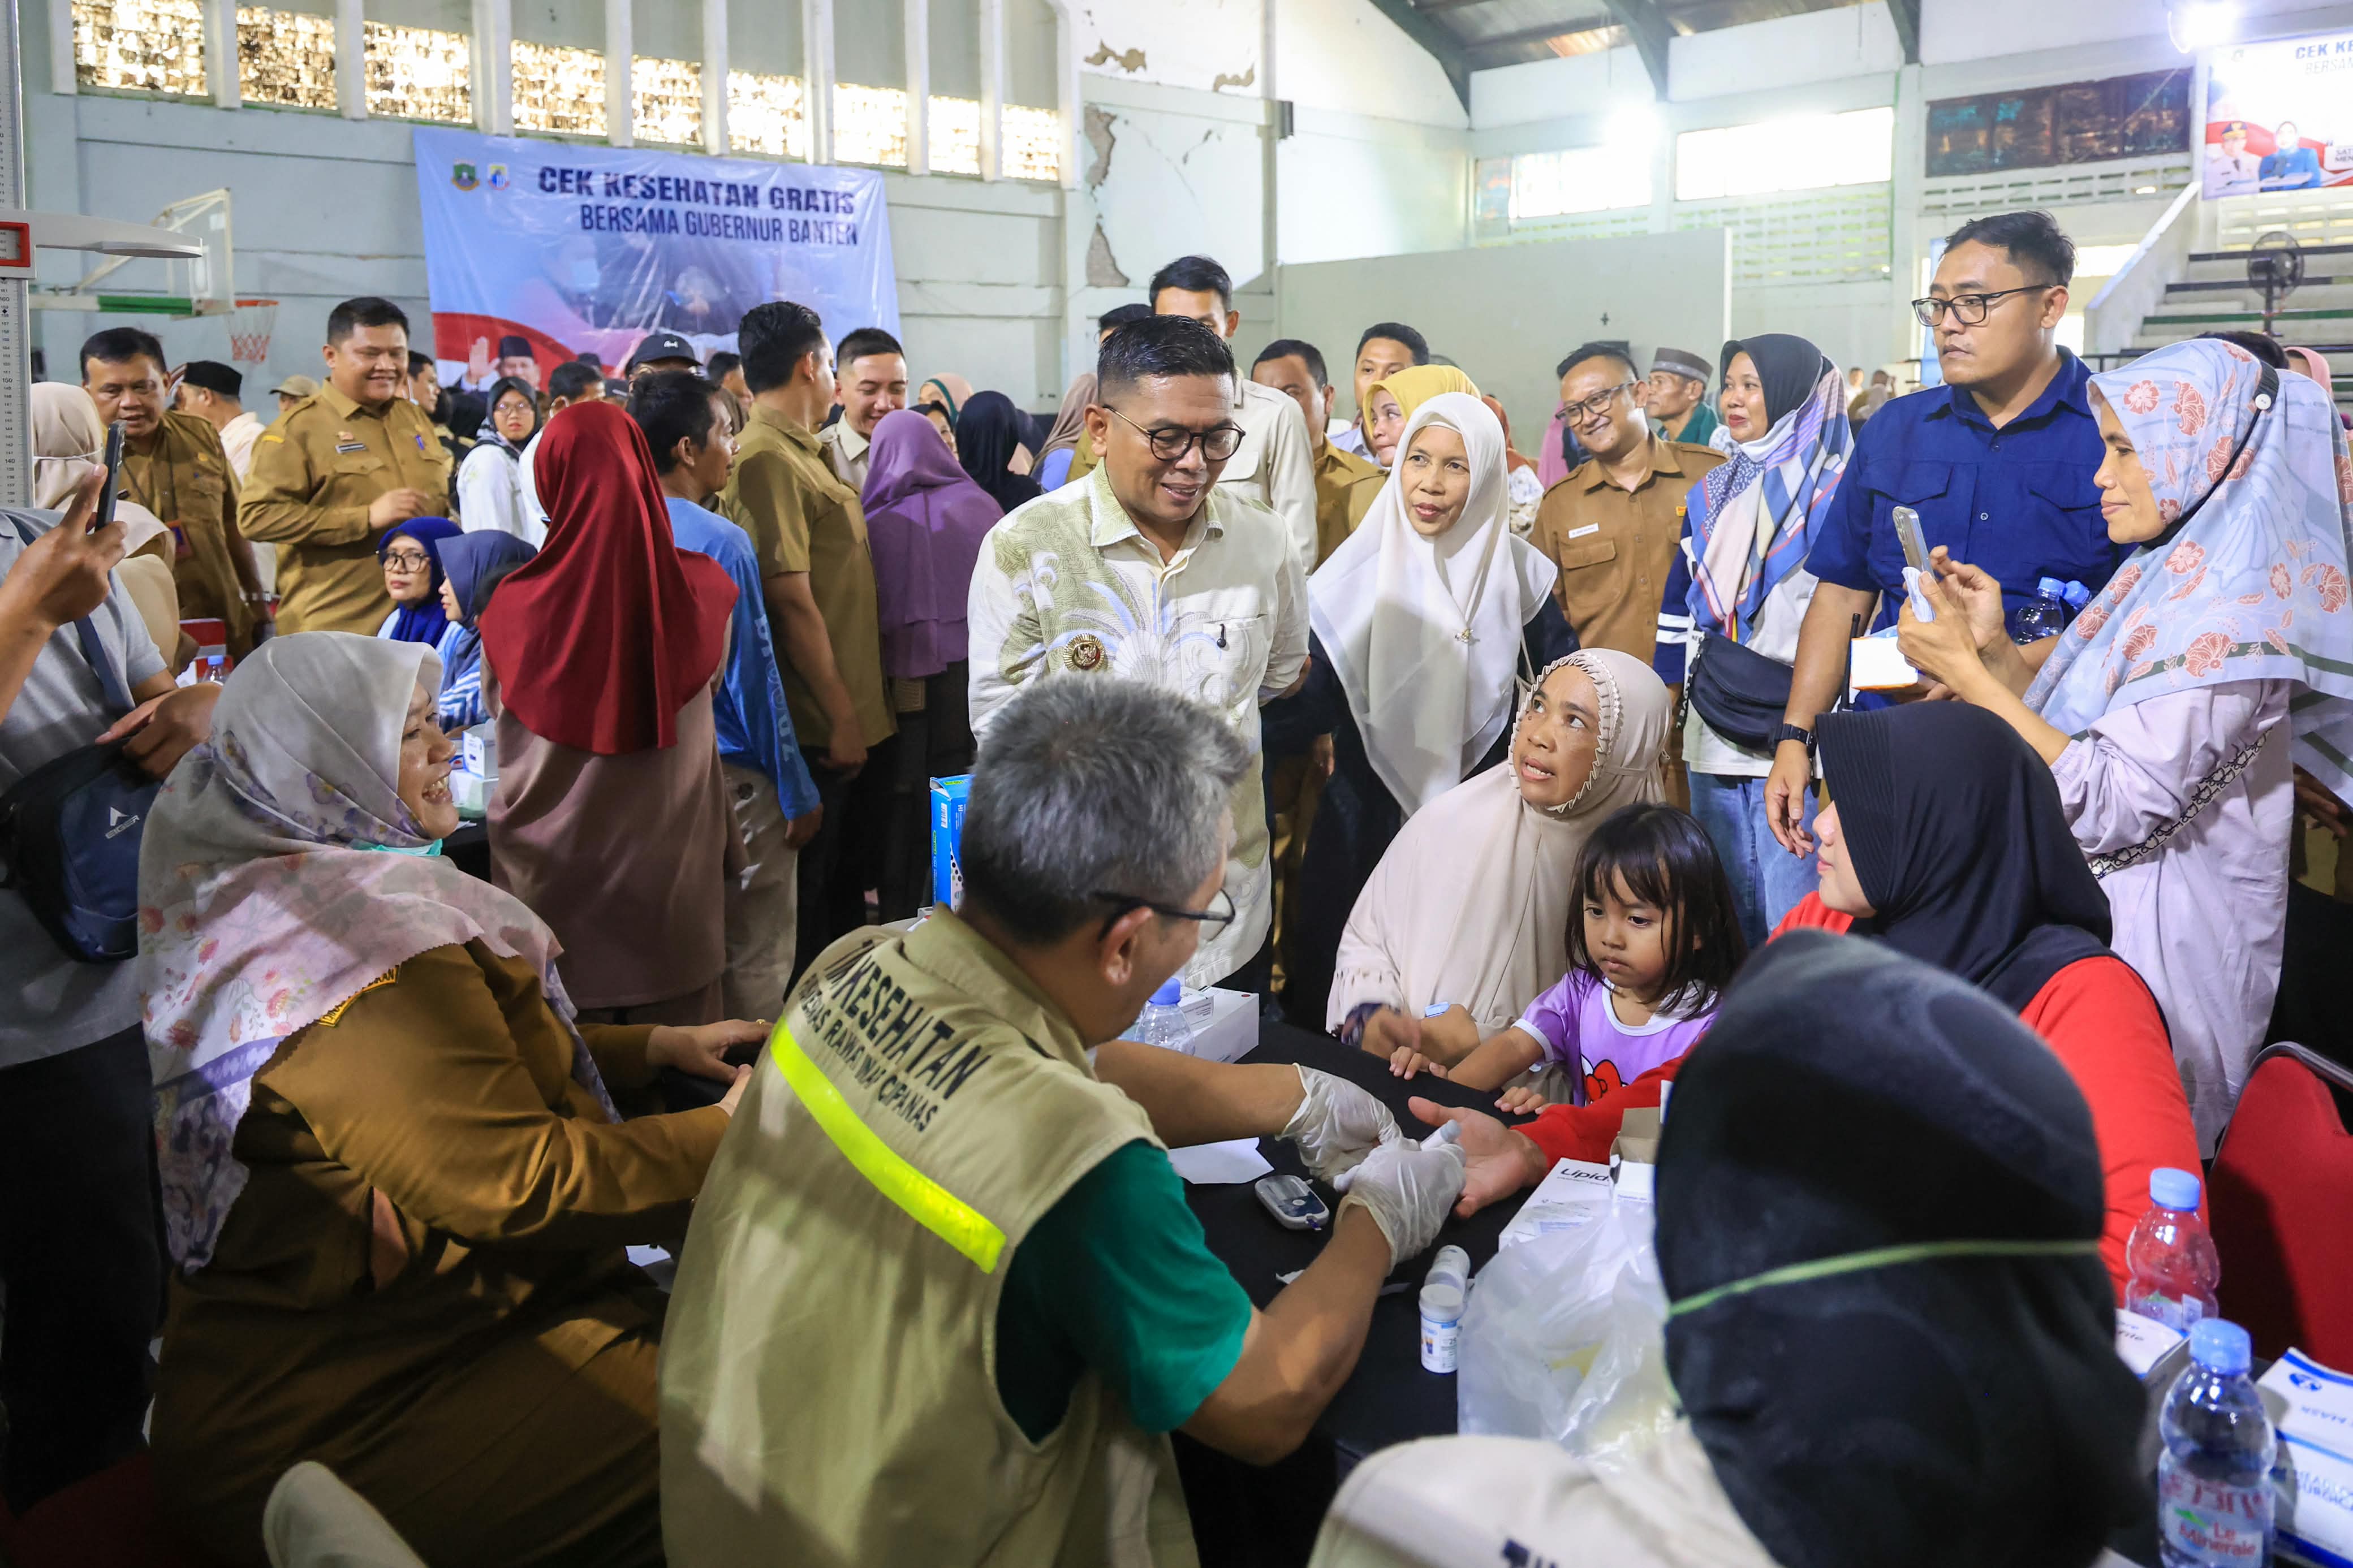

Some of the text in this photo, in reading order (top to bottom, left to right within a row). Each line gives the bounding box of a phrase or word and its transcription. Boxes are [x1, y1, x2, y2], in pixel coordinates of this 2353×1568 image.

[2296, 40, 2353, 59] CEK KE
[538, 166, 855, 215] CEK KESEHATAN GRATIS
[581, 205, 859, 247] BERSAMA GUBERNUR BANTEN
[831, 954, 992, 1100] KESEHATAN
[877, 1074, 938, 1133] CIPANAS
[1561, 1168, 1611, 1182] Lipid
